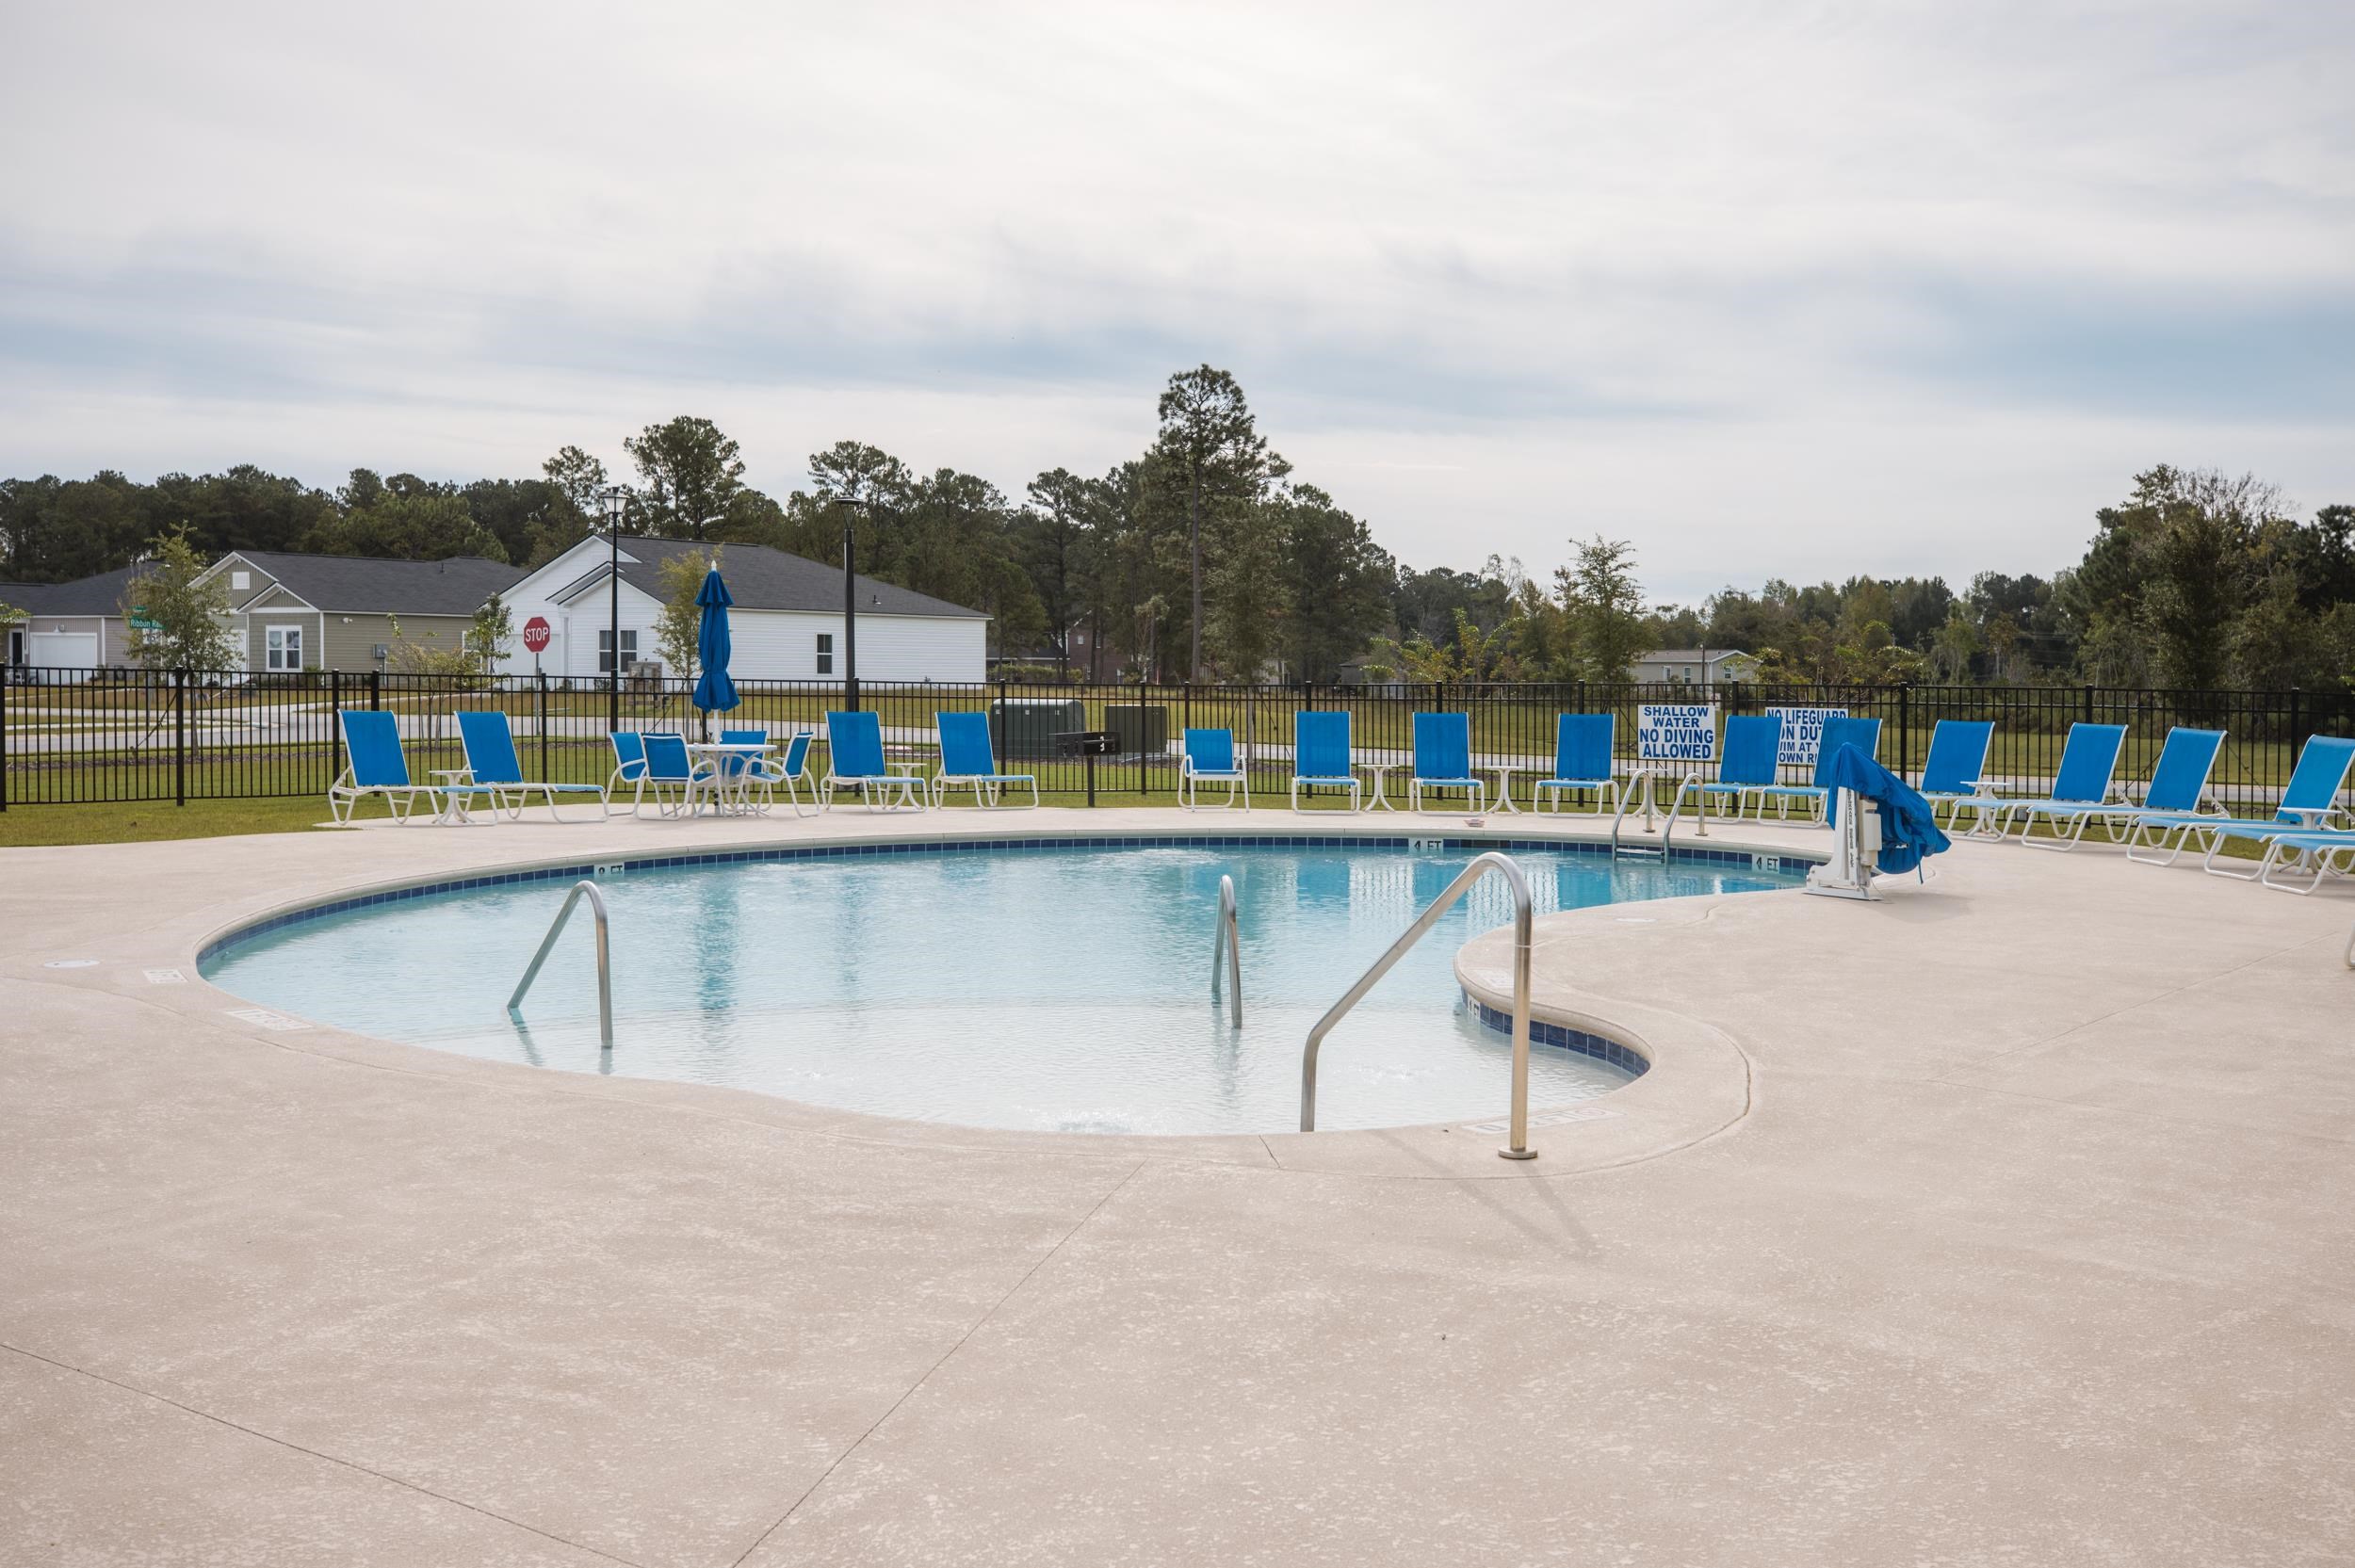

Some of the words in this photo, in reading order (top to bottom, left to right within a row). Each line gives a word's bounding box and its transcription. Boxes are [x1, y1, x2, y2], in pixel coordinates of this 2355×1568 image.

[525, 626, 549, 642] STOP
[1644, 706, 1709, 717] SHALLOW
[1785, 709, 1846, 725] LIFEGUARD
[1652, 717, 1700, 728] WATER
[1639, 728, 1660, 742] NO
[1664, 729, 1713, 744] DIVING
[1800, 725, 1822, 740] DU
[1643, 743, 1712, 759] ALLOWED
[1798, 742, 1812, 752] AT
[1778, 752, 1803, 763] OWN
[1427, 840, 1442, 851] FT
[1766, 858, 1778, 871] FT
